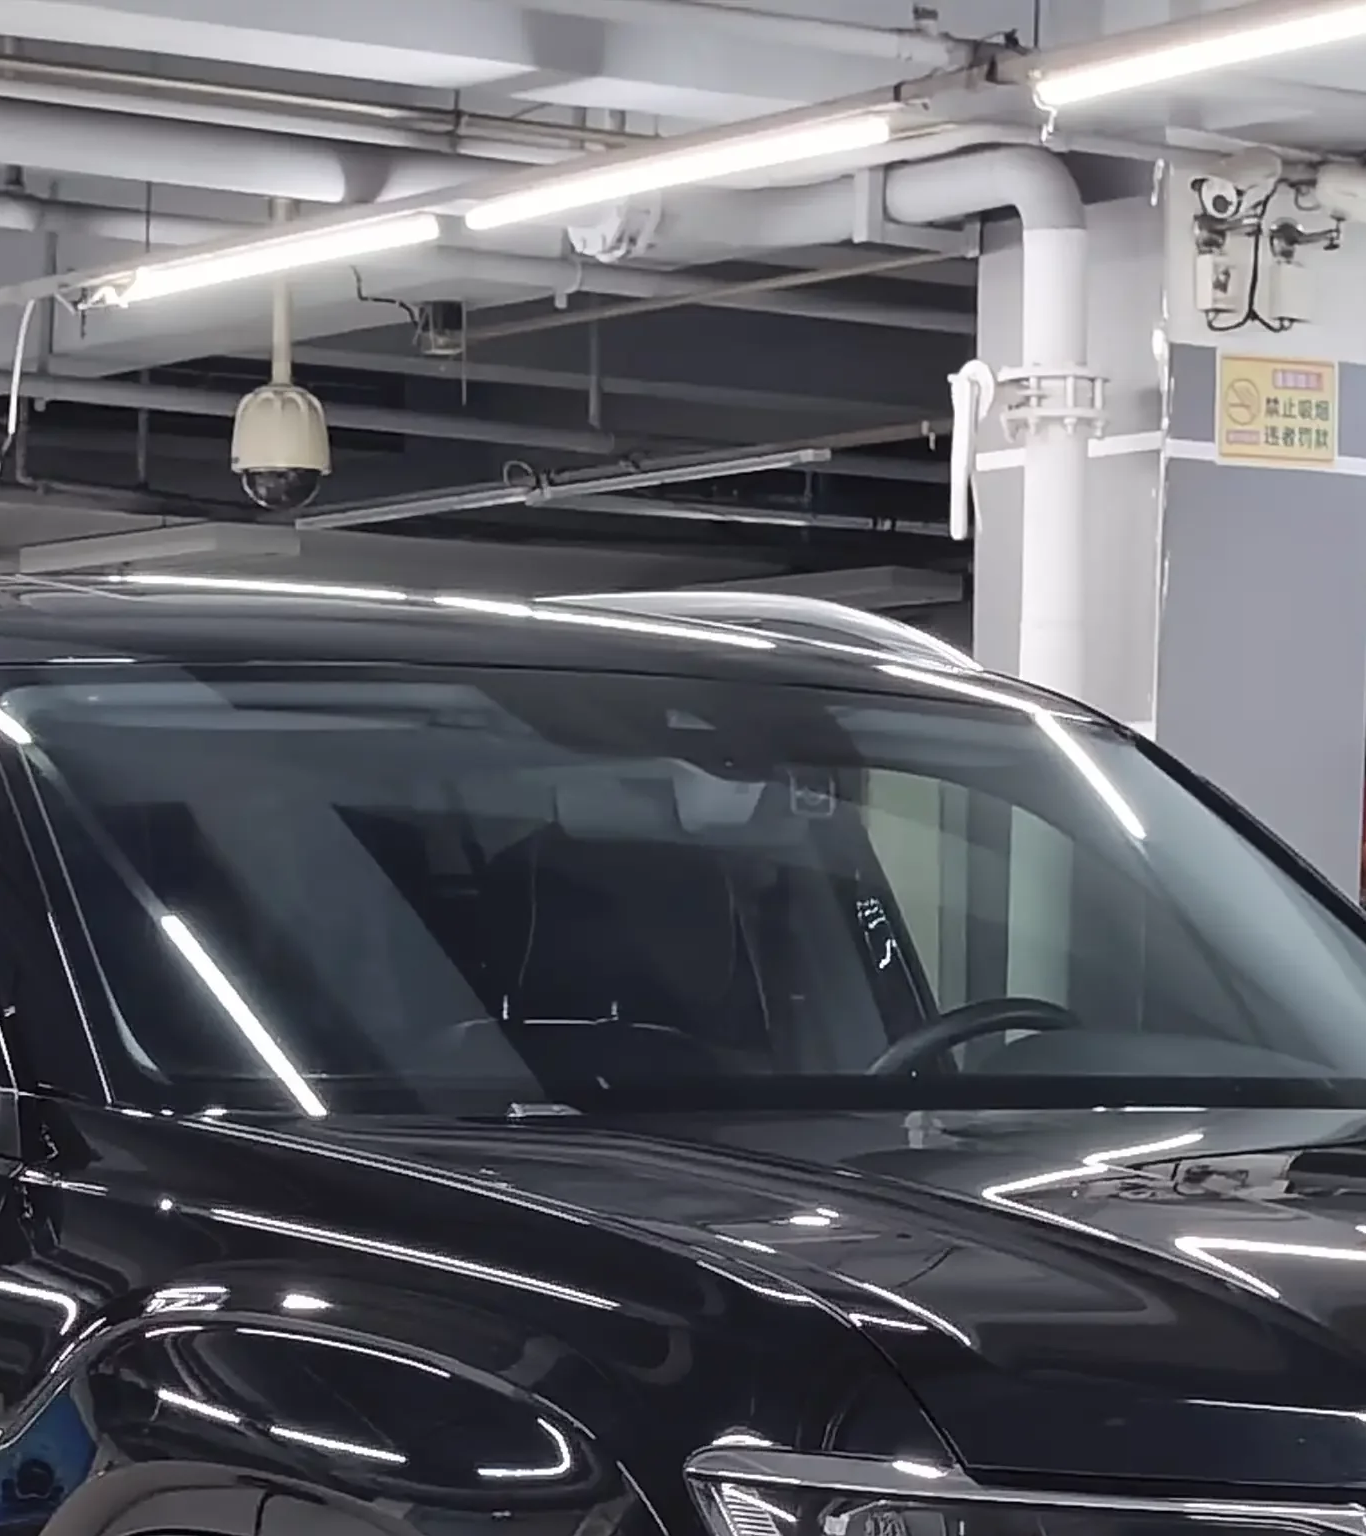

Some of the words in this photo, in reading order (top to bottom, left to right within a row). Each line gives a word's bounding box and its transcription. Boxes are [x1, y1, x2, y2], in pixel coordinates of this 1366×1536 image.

[1264, 396, 1330, 421] 禁止吸烟
[1264, 425, 1329, 449] 违者罚款
